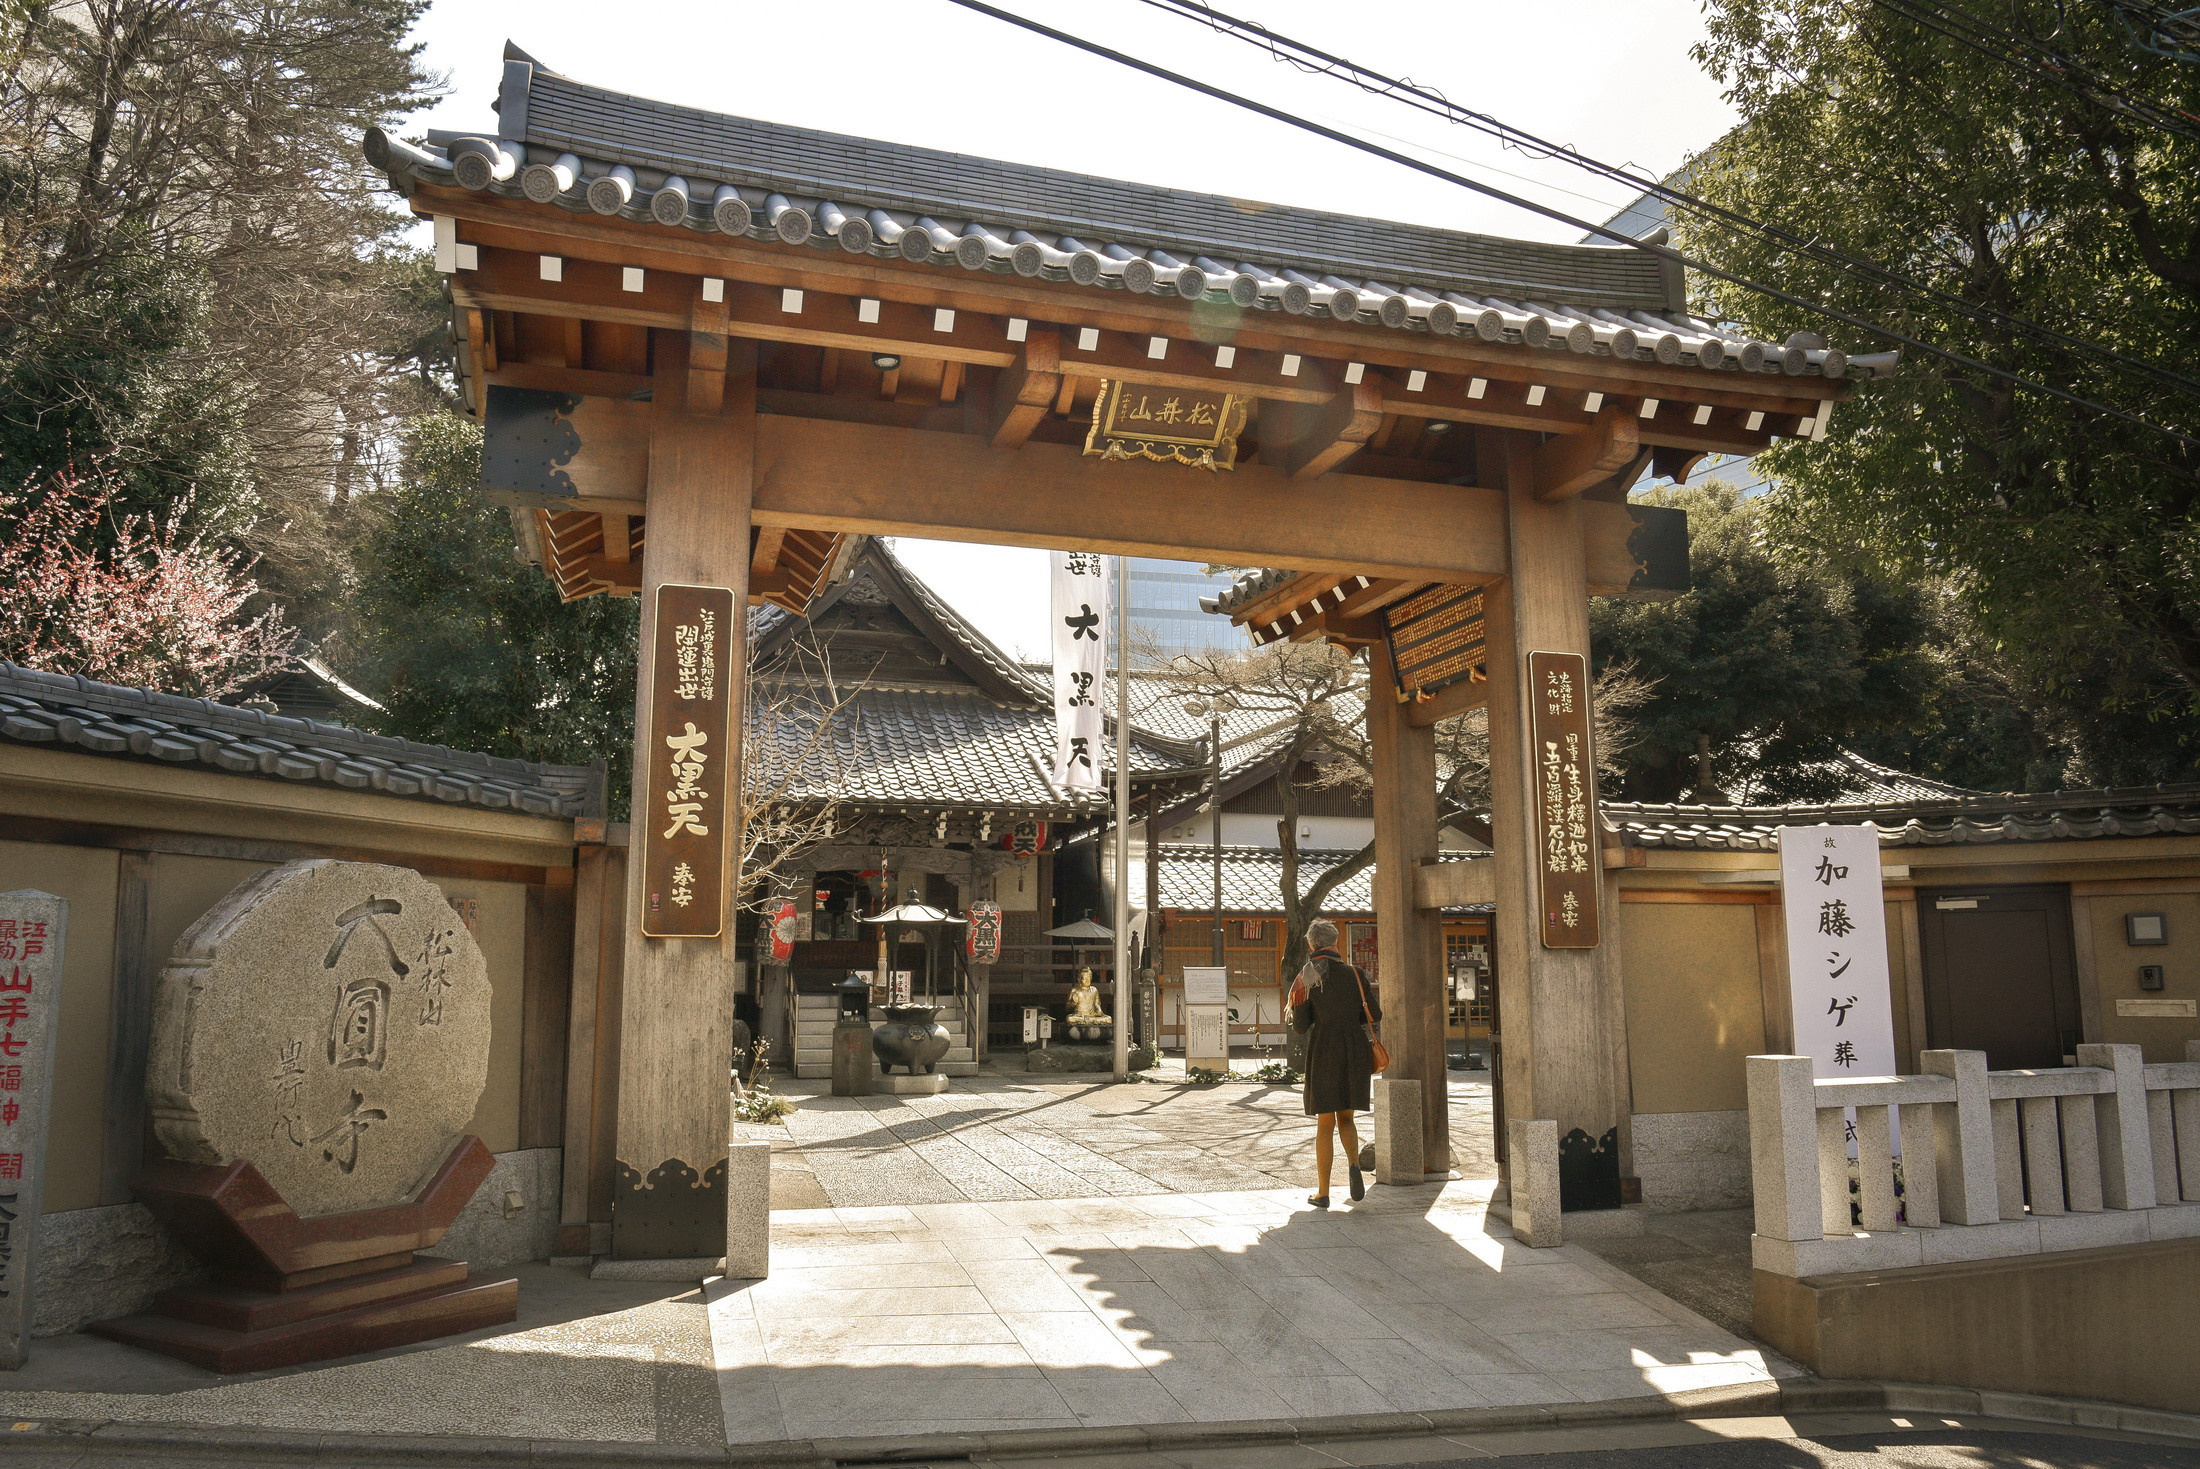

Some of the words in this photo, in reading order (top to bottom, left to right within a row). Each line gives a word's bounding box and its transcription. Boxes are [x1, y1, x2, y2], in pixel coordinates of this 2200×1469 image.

[674, 624, 699, 700] 開運出世
[1064, 603, 1100, 770] 大黒天
[1547, 670, 1560, 716] 文化財
[663, 721, 709, 840] 大黒天
[20, 921, 48, 961] 江戸
[416, 927, 454, 1026] 松林山
[309, 893, 410, 1175] 大圓寺
